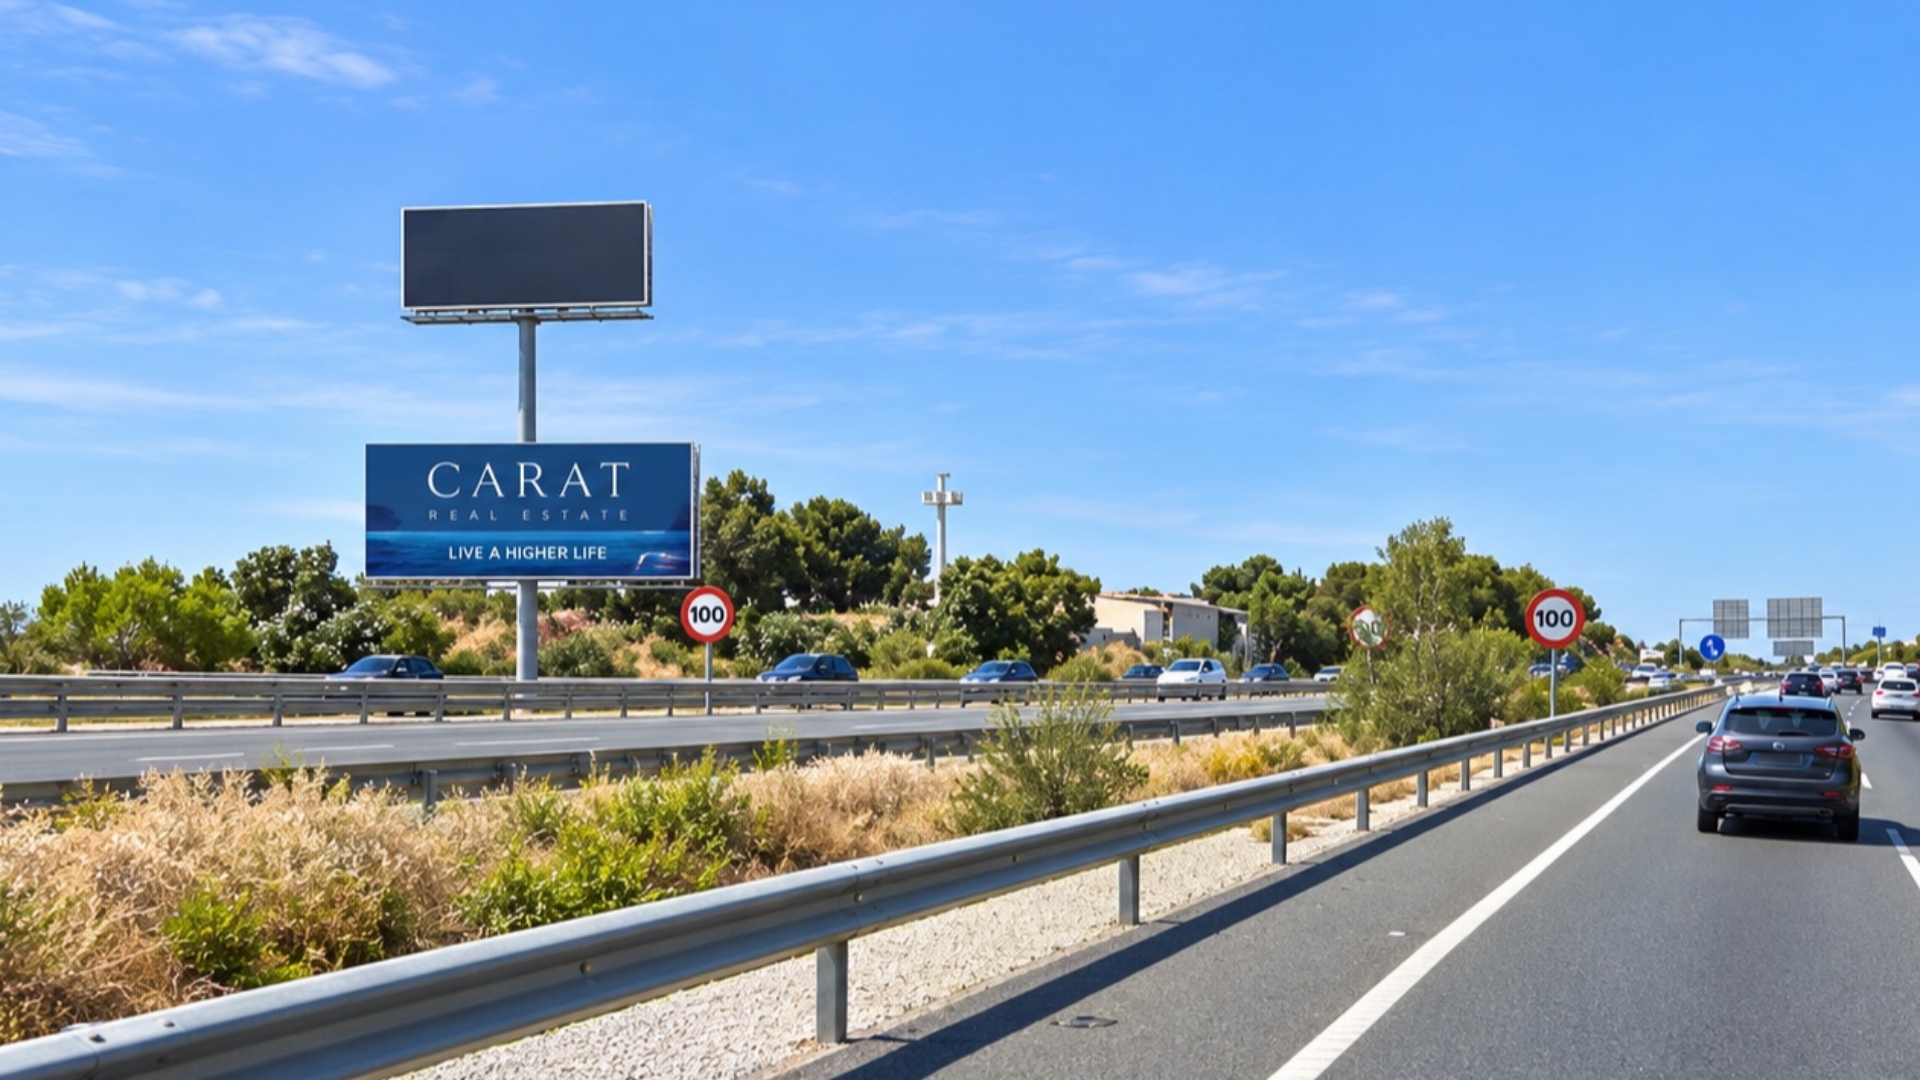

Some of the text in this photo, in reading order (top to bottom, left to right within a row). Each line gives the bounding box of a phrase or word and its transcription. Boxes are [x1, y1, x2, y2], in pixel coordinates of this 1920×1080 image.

[427, 461, 630, 498] CARAT
[428, 509, 627, 521] REAL ESTATE
[449, 546, 607, 560] LIVE A HIGHER LIFE
[690, 605, 725, 624] 100
[1535, 609, 1574, 628] 100
